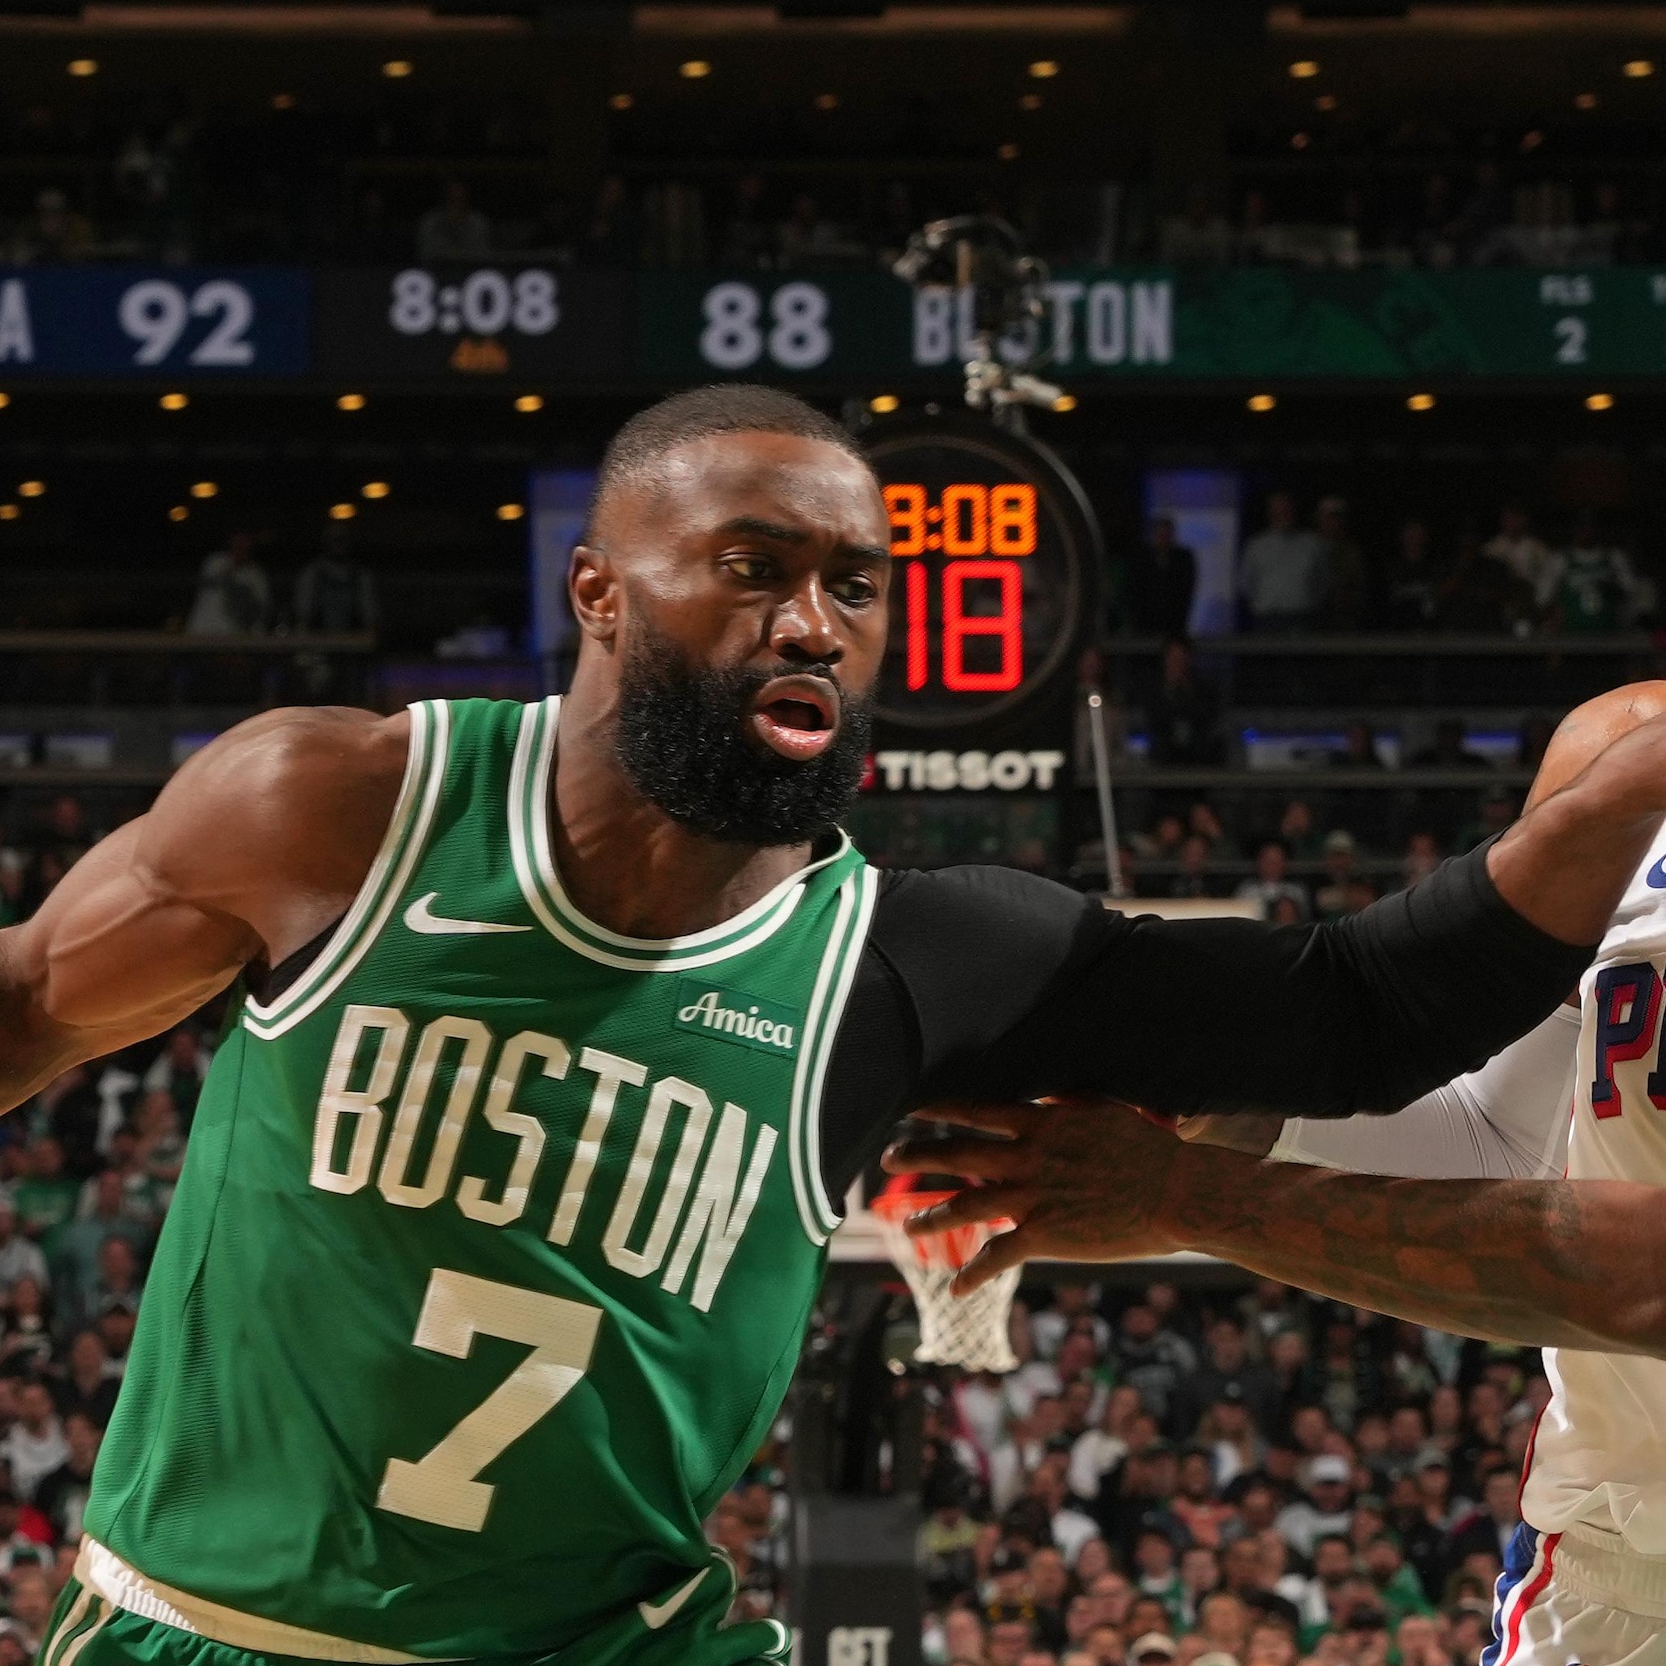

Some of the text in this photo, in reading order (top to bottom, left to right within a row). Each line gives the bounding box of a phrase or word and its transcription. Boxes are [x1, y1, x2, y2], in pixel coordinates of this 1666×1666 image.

[118, 280, 254, 365] 92
[390, 269, 559, 335] 8:08
[700, 282, 831, 369] 88
[1555, 316, 1587, 364] 2
[905, 560, 1024, 692] 18
[876, 749, 1066, 791] TISSOT
[678, 991, 795, 1051] Amica
[309, 1003, 779, 1314] BOSTON
[375, 1266, 604, 1532] 7
